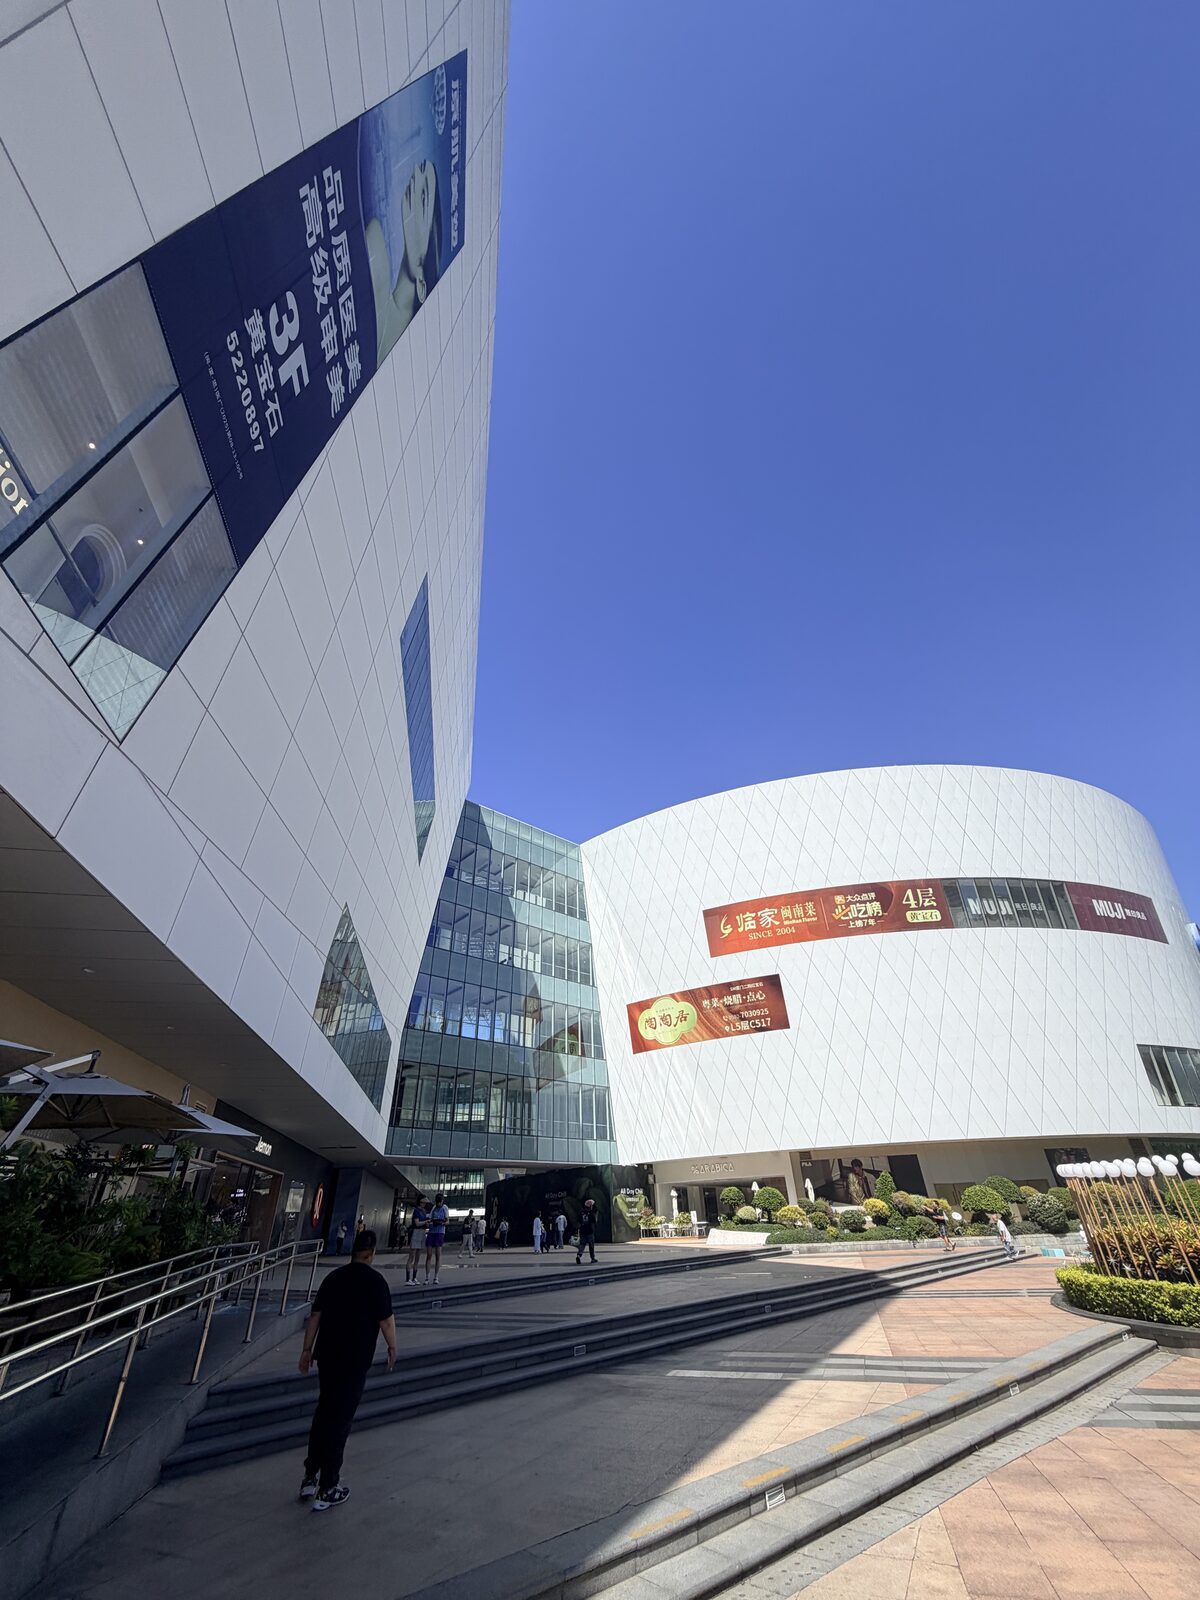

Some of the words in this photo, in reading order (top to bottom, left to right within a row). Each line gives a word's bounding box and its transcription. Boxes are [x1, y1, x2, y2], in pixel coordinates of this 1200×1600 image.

[323, 166, 361, 393] 品质医美
[299, 176, 345, 418] 高级审美
[269, 290, 309, 397] 3F
[244, 308, 283, 438] 黄宝石
[226, 330, 264, 452] 5220897
[846, 892, 876, 902] 大众点评
[902, 887, 937, 909] 4层
[780, 901, 816, 920] 闽南菜
[832, 901, 882, 920] 必吃榜
[910, 911, 939, 922] 黄宝石
[967, 898, 1014, 916] MUJI
[1092, 898, 1127, 920] MUJI
[848, 918, 876, 928] 上榜7年
[748, 930, 774, 941] SINCE
[776, 926, 796, 936] 2004
[731, 1018, 771, 1032] L5层C517
